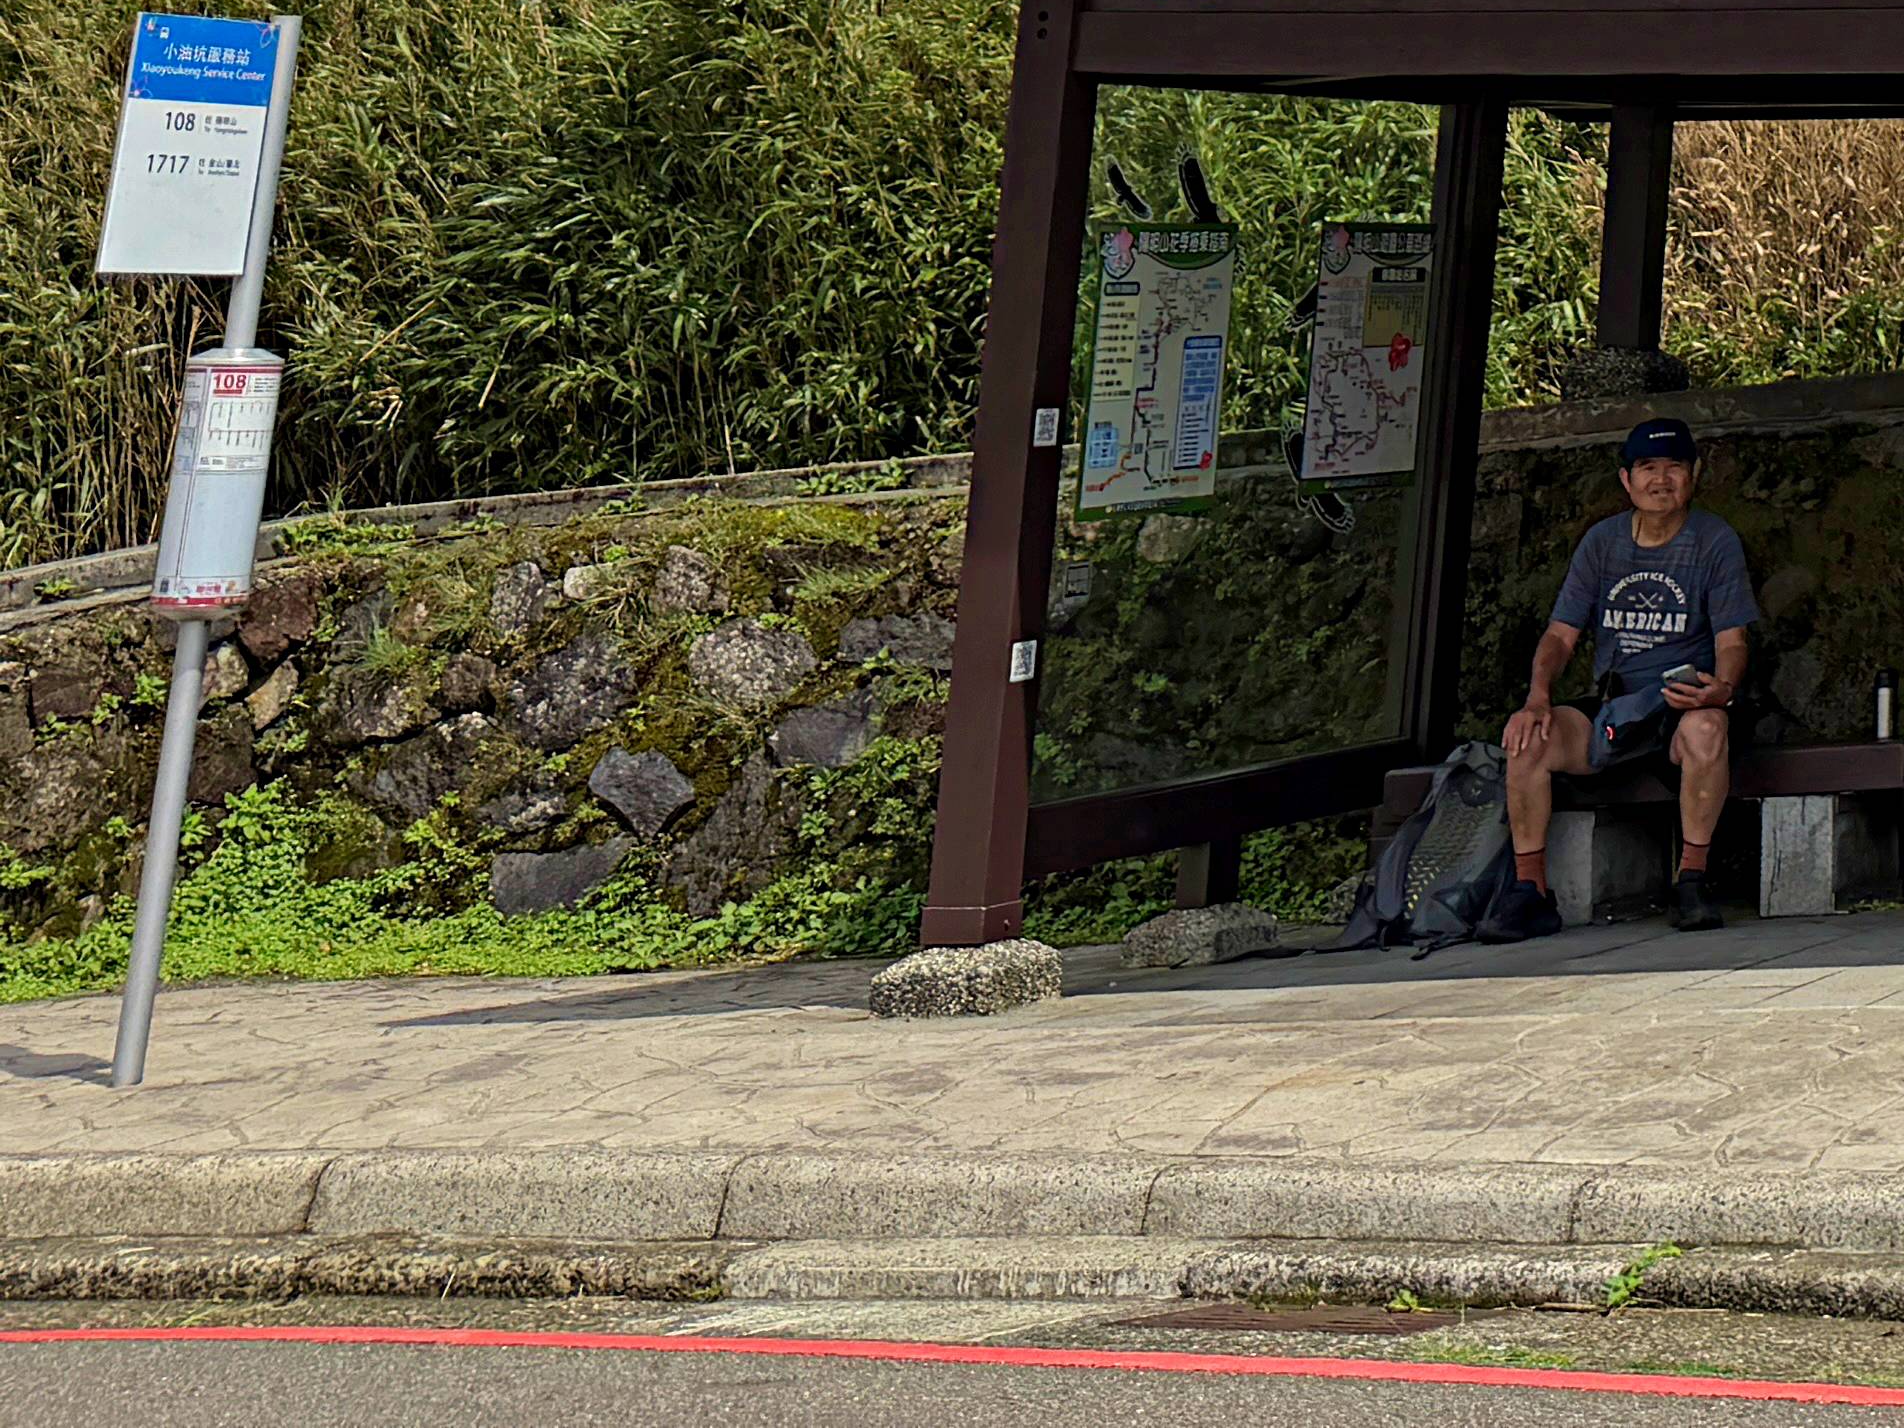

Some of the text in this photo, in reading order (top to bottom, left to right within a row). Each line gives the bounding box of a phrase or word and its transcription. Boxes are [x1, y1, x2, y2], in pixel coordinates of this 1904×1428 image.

[163, 42, 252, 66] 小油坑服務站
[203, 65, 234, 80] Service
[236, 68, 266, 82] Center
[165, 111, 196, 132] 108
[147, 154, 190, 175] 1717
[213, 374, 247, 389] 108
[1650, 572, 1664, 582] ICE
[1602, 609, 1688, 633] AMERICAN
